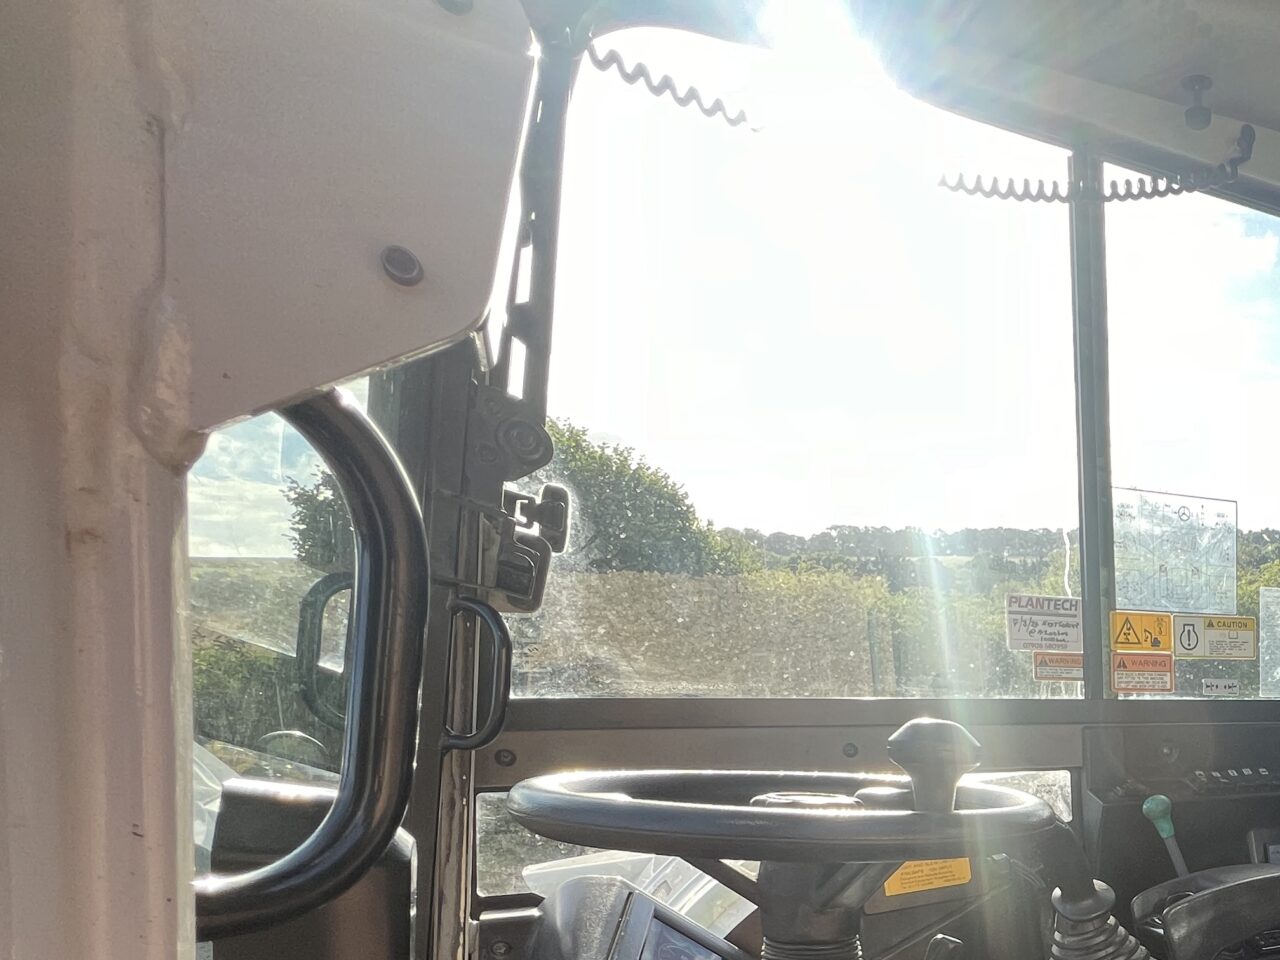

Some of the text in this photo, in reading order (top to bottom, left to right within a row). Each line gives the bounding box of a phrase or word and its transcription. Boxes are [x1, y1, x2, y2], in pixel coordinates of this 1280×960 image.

[1008, 596, 1078, 612] PLANTECH
[1216, 620, 1248, 629] CAUTION
[1131, 660, 1167, 668] WARNING
